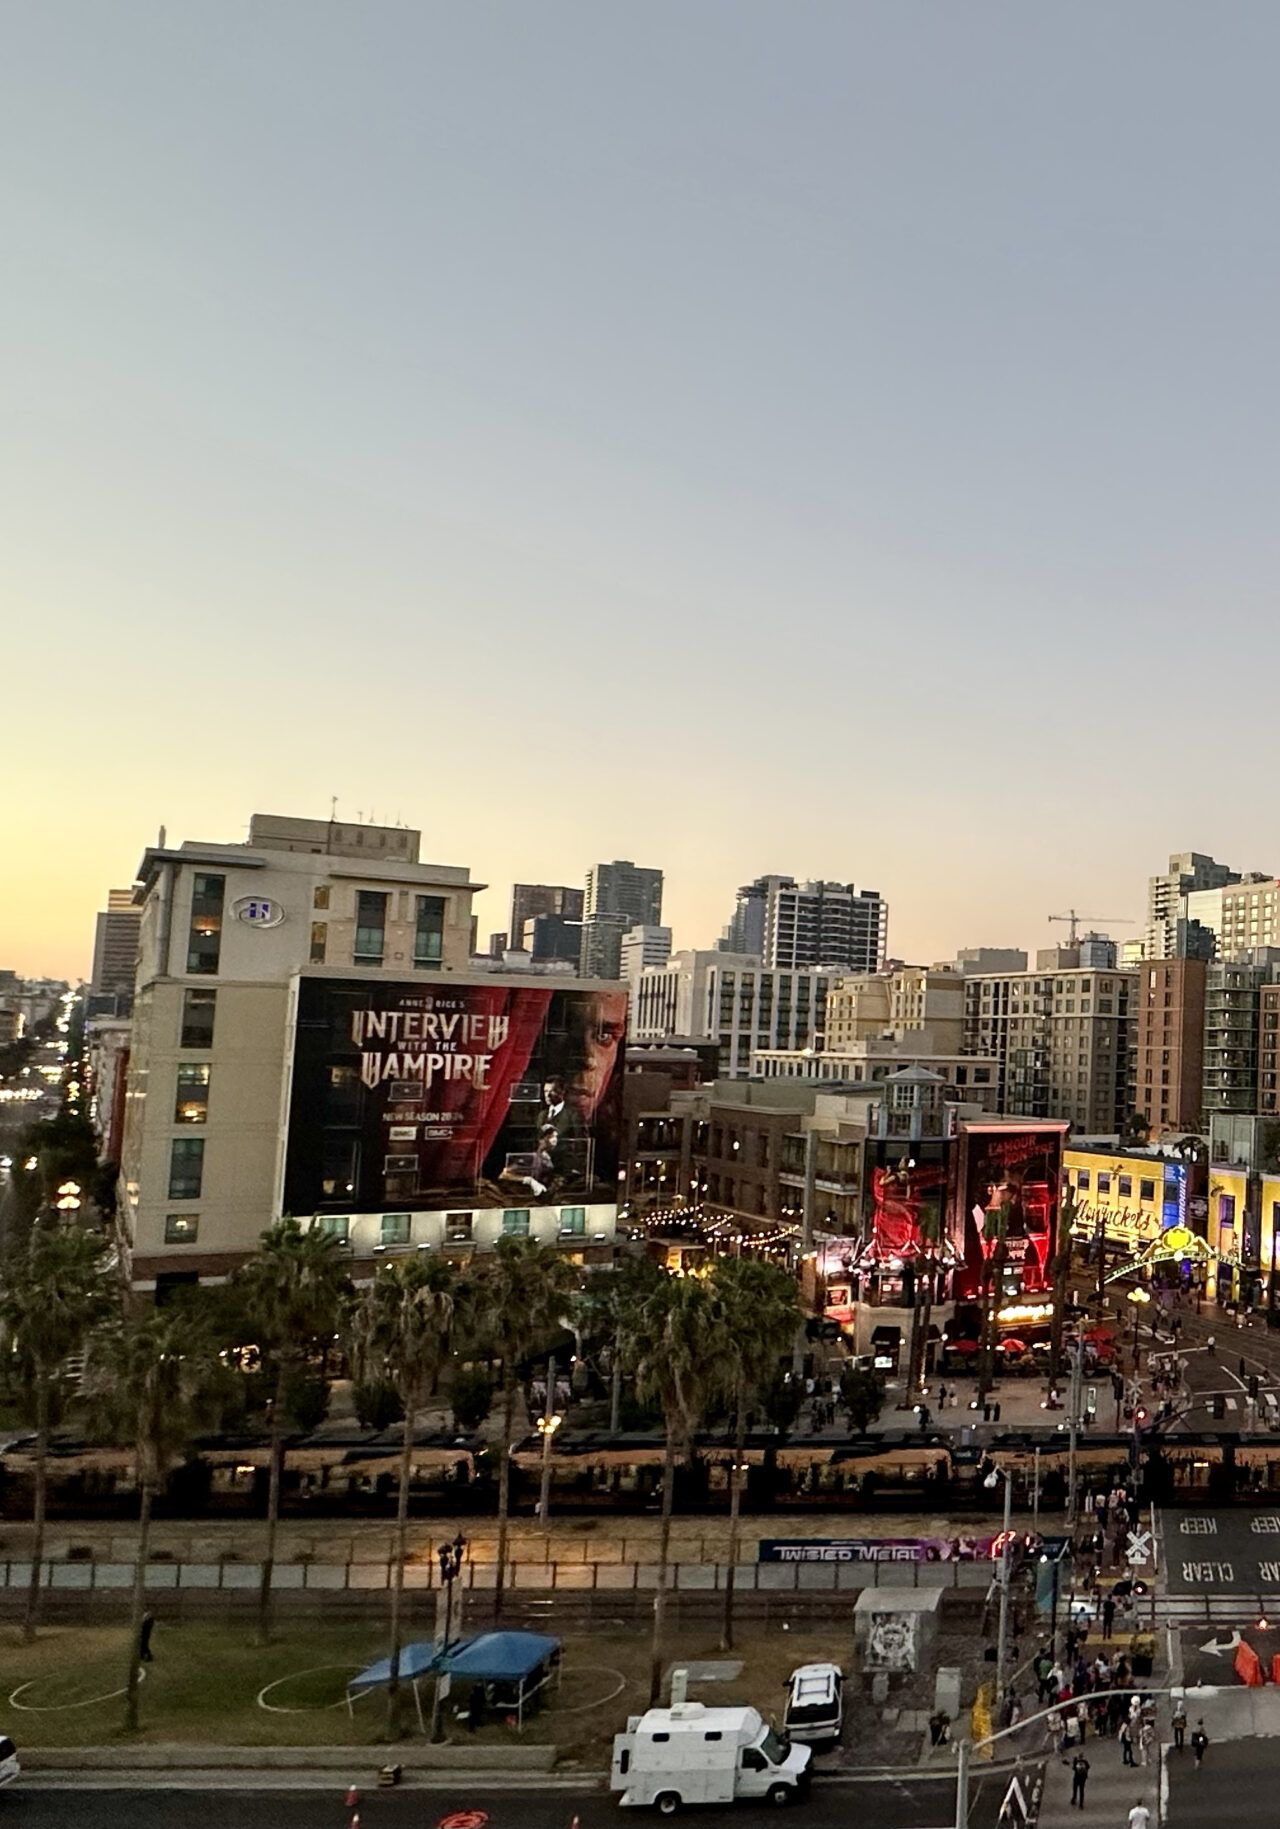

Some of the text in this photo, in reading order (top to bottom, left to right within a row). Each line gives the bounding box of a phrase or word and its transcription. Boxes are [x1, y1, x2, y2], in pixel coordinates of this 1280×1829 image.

[351, 1010, 510, 1051] INTERVIEW
[397, 1041, 458, 1051] WITH THE
[361, 1052, 494, 1091] VAMPIRE
[405, 1111, 440, 1121] SEASON
[1180, 1517, 1218, 1535] KEEP
[1182, 1561, 1235, 1583] CLEAR
